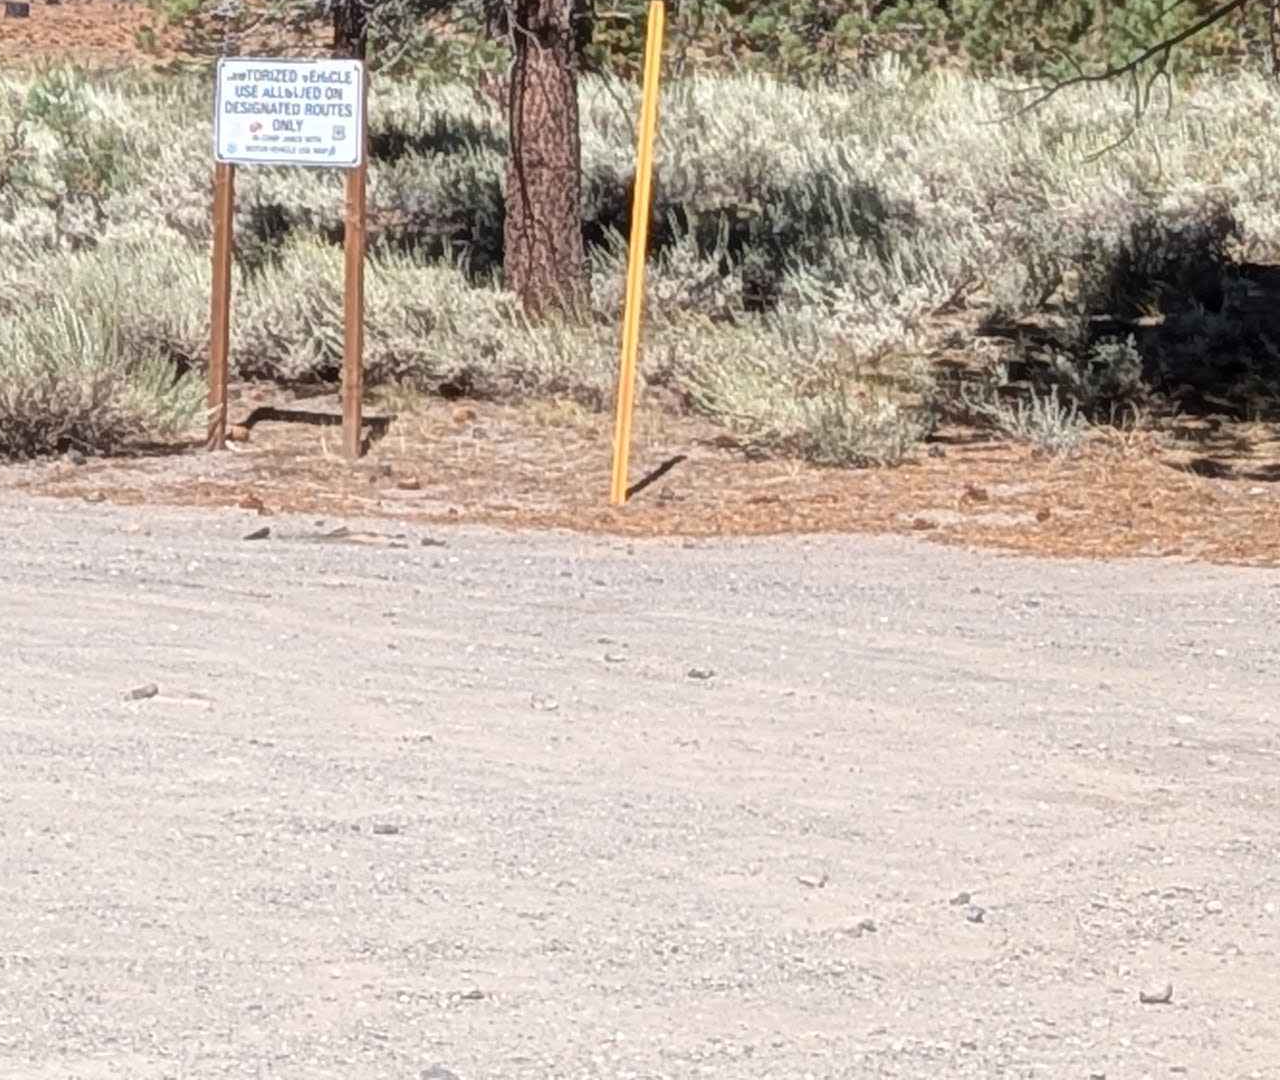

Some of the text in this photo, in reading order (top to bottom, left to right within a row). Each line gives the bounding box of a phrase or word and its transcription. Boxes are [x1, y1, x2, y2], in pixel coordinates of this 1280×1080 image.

[234, 85, 258, 98] USE
[325, 87, 343, 100] ON
[225, 101, 352, 117] DESIGNATED ROUTES
[272, 119, 303, 132] ONLY
